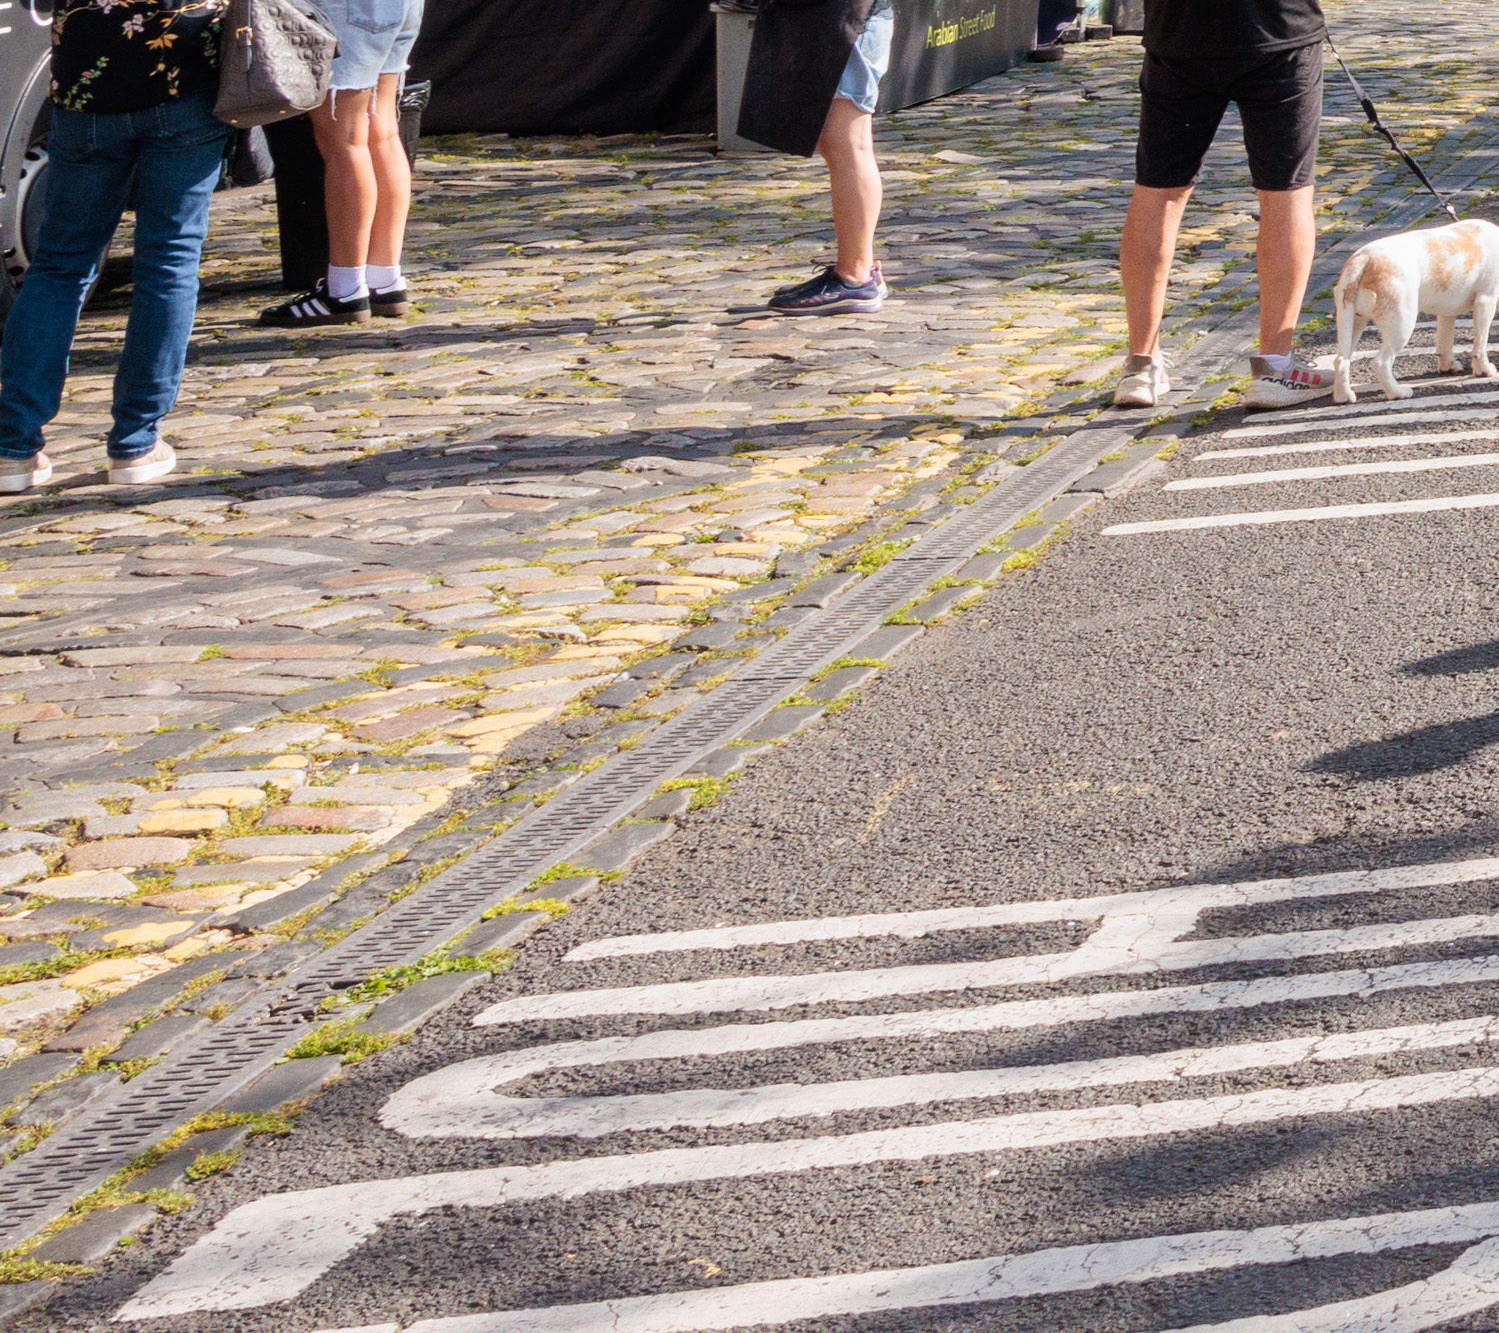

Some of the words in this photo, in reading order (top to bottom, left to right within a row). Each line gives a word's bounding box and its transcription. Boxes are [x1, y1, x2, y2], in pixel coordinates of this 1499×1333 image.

[926, 23, 959, 49] Arabian
[958, 15, 979, 40] Street
[979, 4, 996, 33] Food
